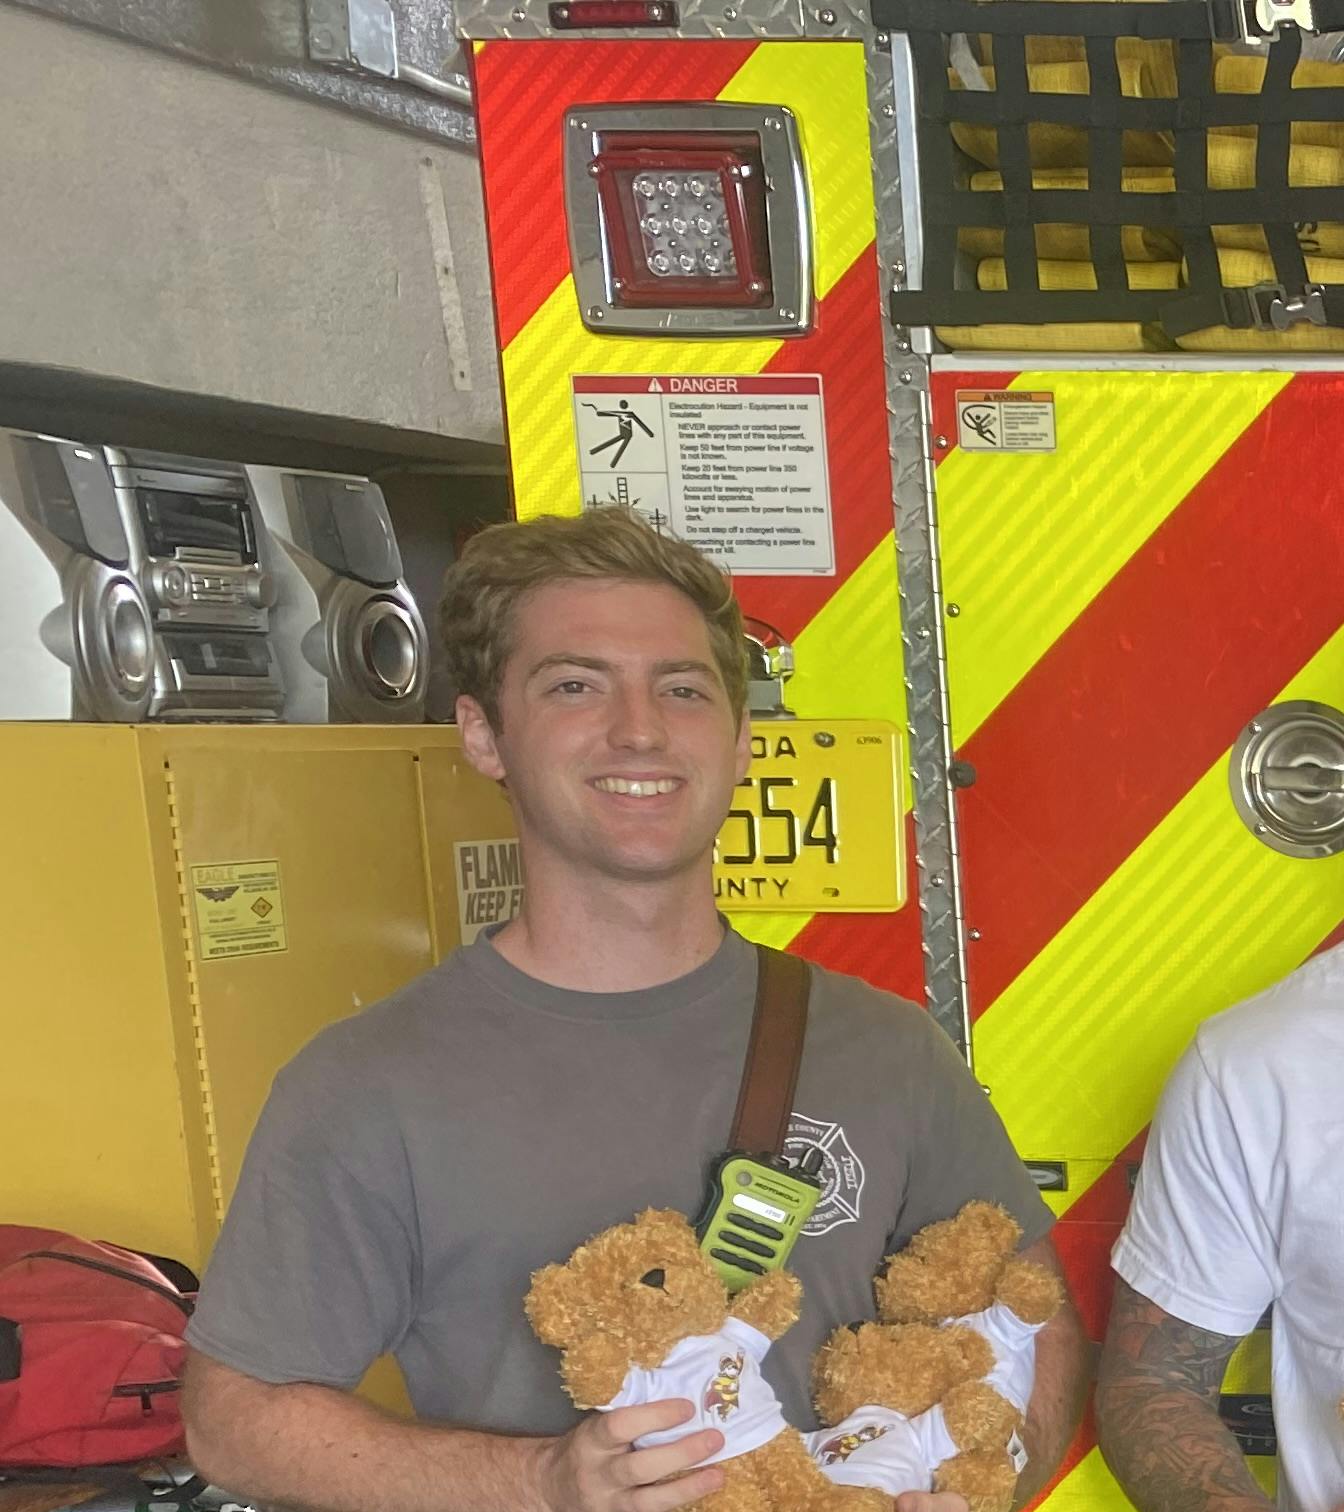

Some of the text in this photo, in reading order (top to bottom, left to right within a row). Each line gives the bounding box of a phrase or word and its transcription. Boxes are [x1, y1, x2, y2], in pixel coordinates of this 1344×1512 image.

[669, 378, 738, 393] DANGER
[716, 777, 840, 864] 554
[465, 890, 506, 925] KEEP
[754, 1182, 800, 1203] MOTOROLA
